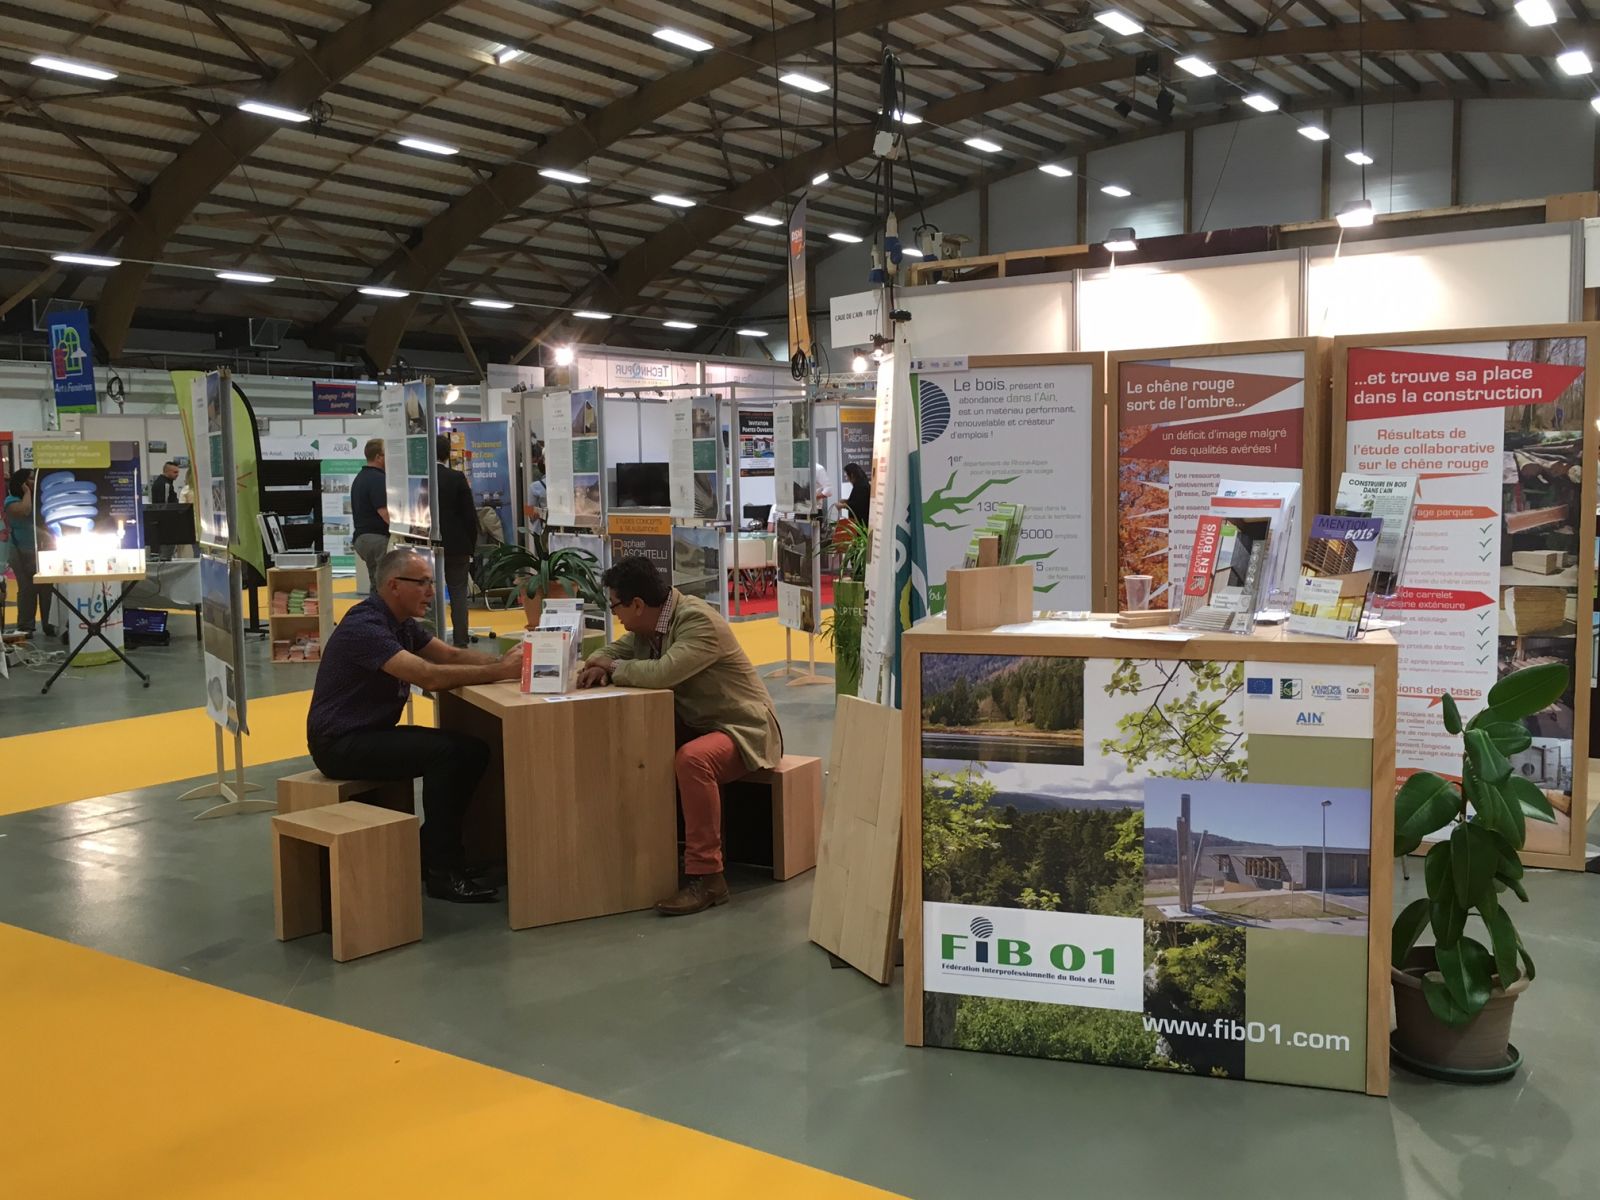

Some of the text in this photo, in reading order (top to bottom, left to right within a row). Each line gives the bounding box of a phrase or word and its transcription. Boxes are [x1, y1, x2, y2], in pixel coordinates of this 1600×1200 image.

[1354, 366, 1532, 386] ...et trouve sa place
[954, 378, 970, 392] Le
[1009, 382, 1042, 392] présent
[1127, 379, 1235, 394] Le chêne rouge
[959, 396, 1004, 404] abondance
[1006, 393, 1031, 402] dans
[1354, 385, 1542, 404] dans la construction
[1126, 395, 1245, 411] sort de l'ombre...
[986, 406, 1023, 415] matériau
[954, 418, 1005, 427] renouvelable
[1018, 418, 1055, 426] créateur
[950, 432, 988, 440] d'emplois
[1177, 430, 1206, 440] déficit
[1208, 429, 1247, 441] d'image
[1250, 428, 1287, 441] malgré
[1378, 428, 1466, 440] Résultats de
[1170, 444, 1278, 456] des qualités avérées !
[1354, 442, 1495, 455] l'étude collaborative
[1358, 458, 1488, 471] sur le chêne rouge
[1349, 479, 1385, 488] CONSTRUIRE
[1416, 509, 1474, 517] age parquet
[1318, 518, 1368, 529] MENTION
[1199, 524, 1217, 573] EN BOIS
[1036, 562, 1044, 571] 5
[1418, 601, 1466, 609] extérieure
[1397, 684, 1482, 696] ions des tests
[1296, 712, 1322, 723] AIN
[1050, 944, 1114, 974] 01
[942, 963, 980, 972] Fédération
[982, 966, 1055, 980] Interprofessionnelle
[1069, 975, 1085, 983] Bois
[1142, 1016, 1349, 1051] www.fib01.com
